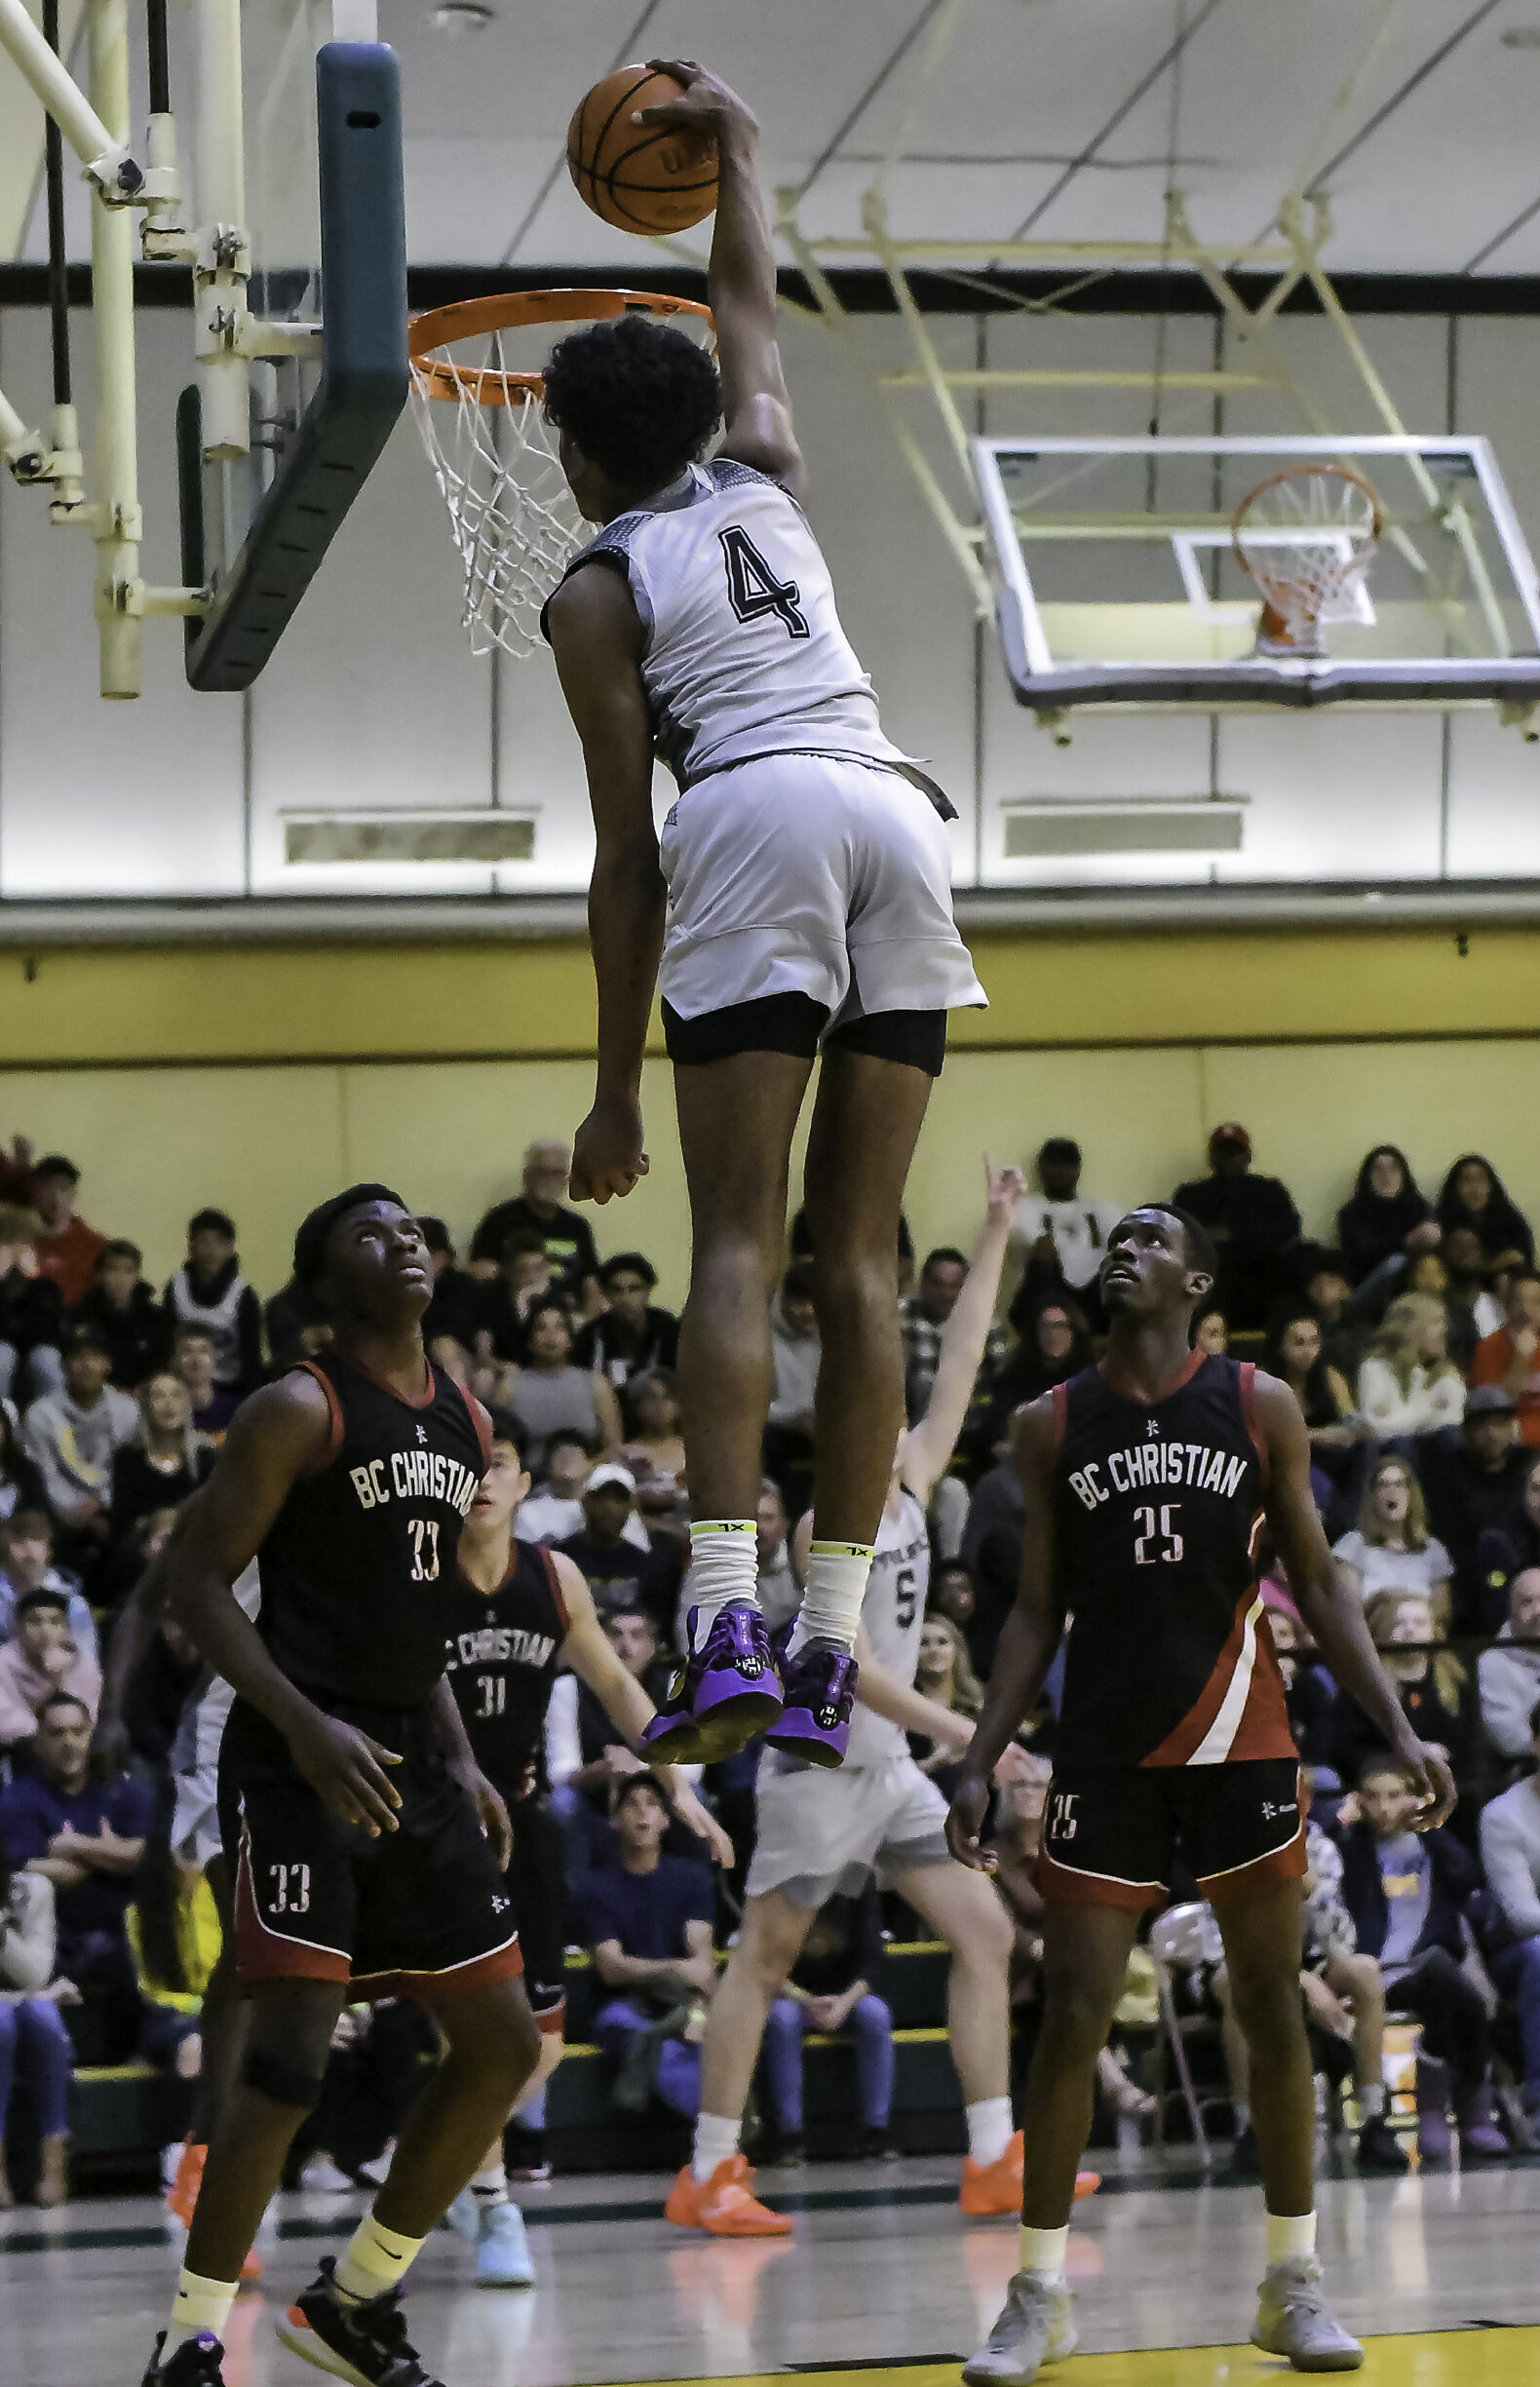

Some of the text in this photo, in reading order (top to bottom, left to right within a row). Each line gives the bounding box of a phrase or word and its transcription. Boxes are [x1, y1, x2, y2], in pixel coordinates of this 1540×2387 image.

[718, 524, 811, 638] 4
[349, 1459, 390, 1509] BC
[1068, 1443, 1248, 1510] BC CHRISTIAN
[407, 1520, 440, 1581] 33
[1134, 1504, 1183, 1564] 25
[896, 1568, 917, 1631] 5
[1051, 1794, 1081, 1839] 25
[268, 1864, 310, 1912] 33
